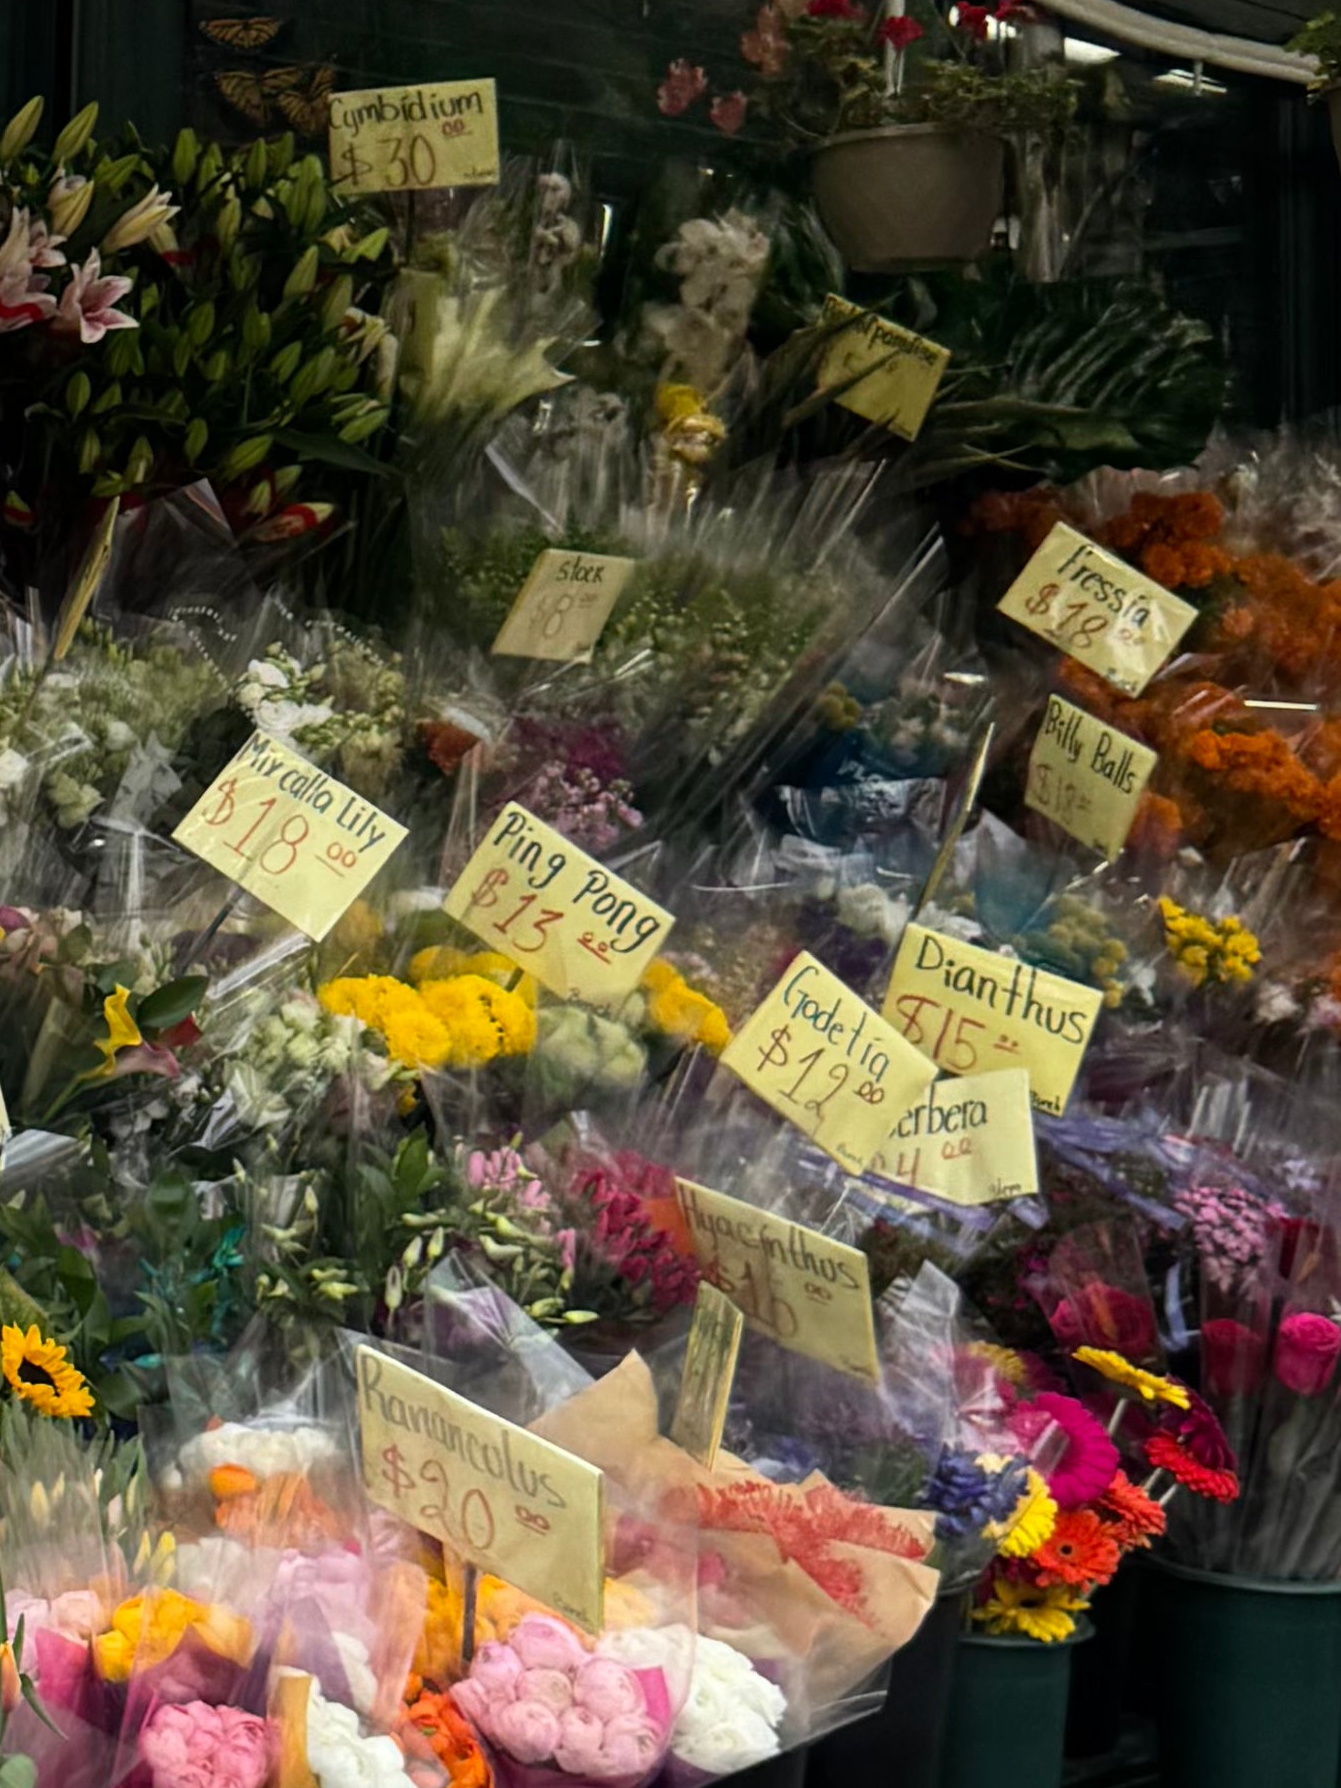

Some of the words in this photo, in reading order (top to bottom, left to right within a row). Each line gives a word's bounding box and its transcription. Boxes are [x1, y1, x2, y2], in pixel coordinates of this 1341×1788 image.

[328, 90, 484, 138] Cymbidium
[338, 133, 436, 188] $30
[1024, 582, 1109, 650] $18
[1044, 699, 1085, 764] Billy
[1090, 730, 1137, 795] Balls
[201, 777, 310, 876] $18
[470, 867, 565, 953] $13
[492, 810, 567, 890] Ping
[572, 869, 662, 954] Pong
[781, 964, 891, 1083] Godetia
[895, 993, 986, 1071] $15
[914, 934, 1089, 1045] Dianthus
[755, 1023, 849, 1125] $12
[889, 1081, 988, 1140] erbera
[381, 1443, 495, 1559] $20
